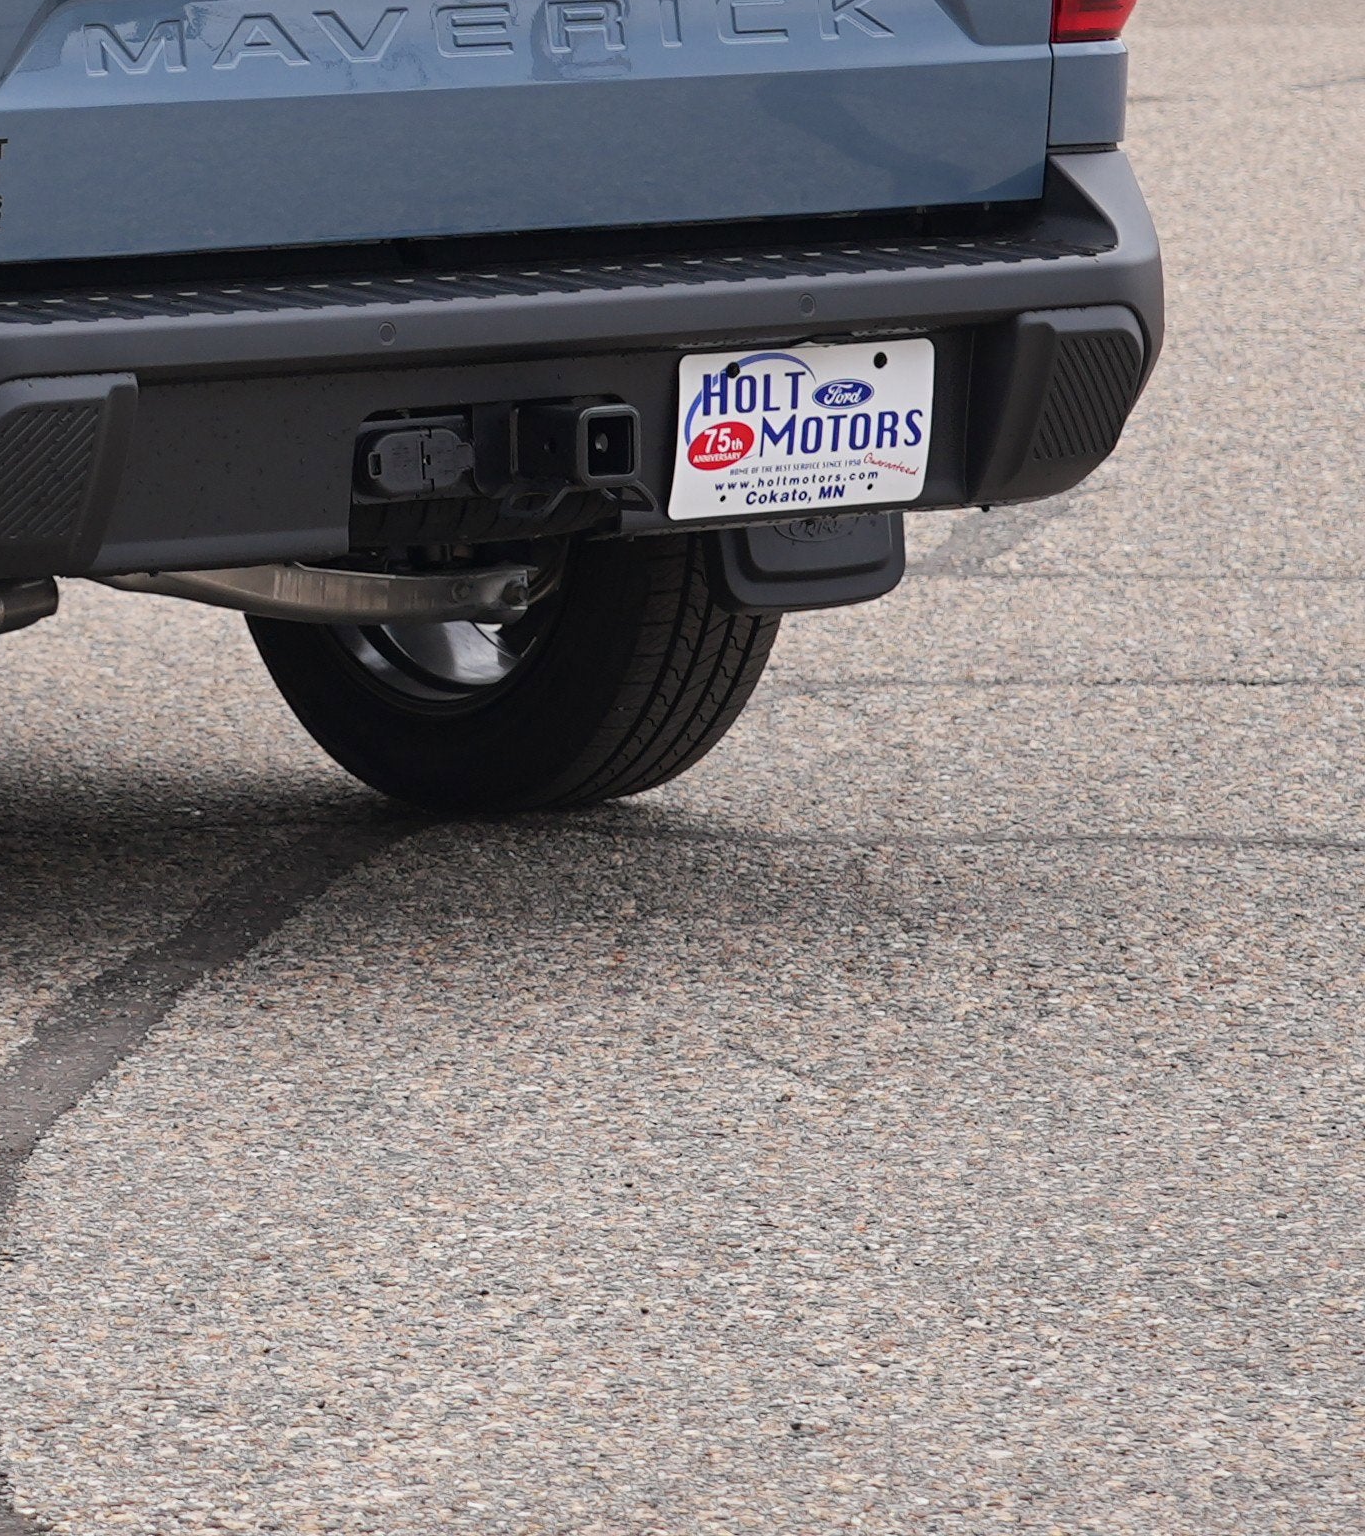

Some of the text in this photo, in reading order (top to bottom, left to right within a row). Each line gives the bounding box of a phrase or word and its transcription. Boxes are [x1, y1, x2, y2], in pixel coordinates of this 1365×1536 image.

[702, 371, 806, 417] HOLT
[823, 383, 862, 405] Ford
[703, 427, 744, 454] 75th
[759, 408, 924, 458] MOTORS
[692, 451, 743, 464] ANNIVERSARY
[762, 465, 773, 473] THE
[775, 464, 791, 472] BEST
[822, 460, 842, 469] SINCE
[714, 470, 879, 492] www.holtmotors.com
[745, 484, 846, 506] Cokato, MN
